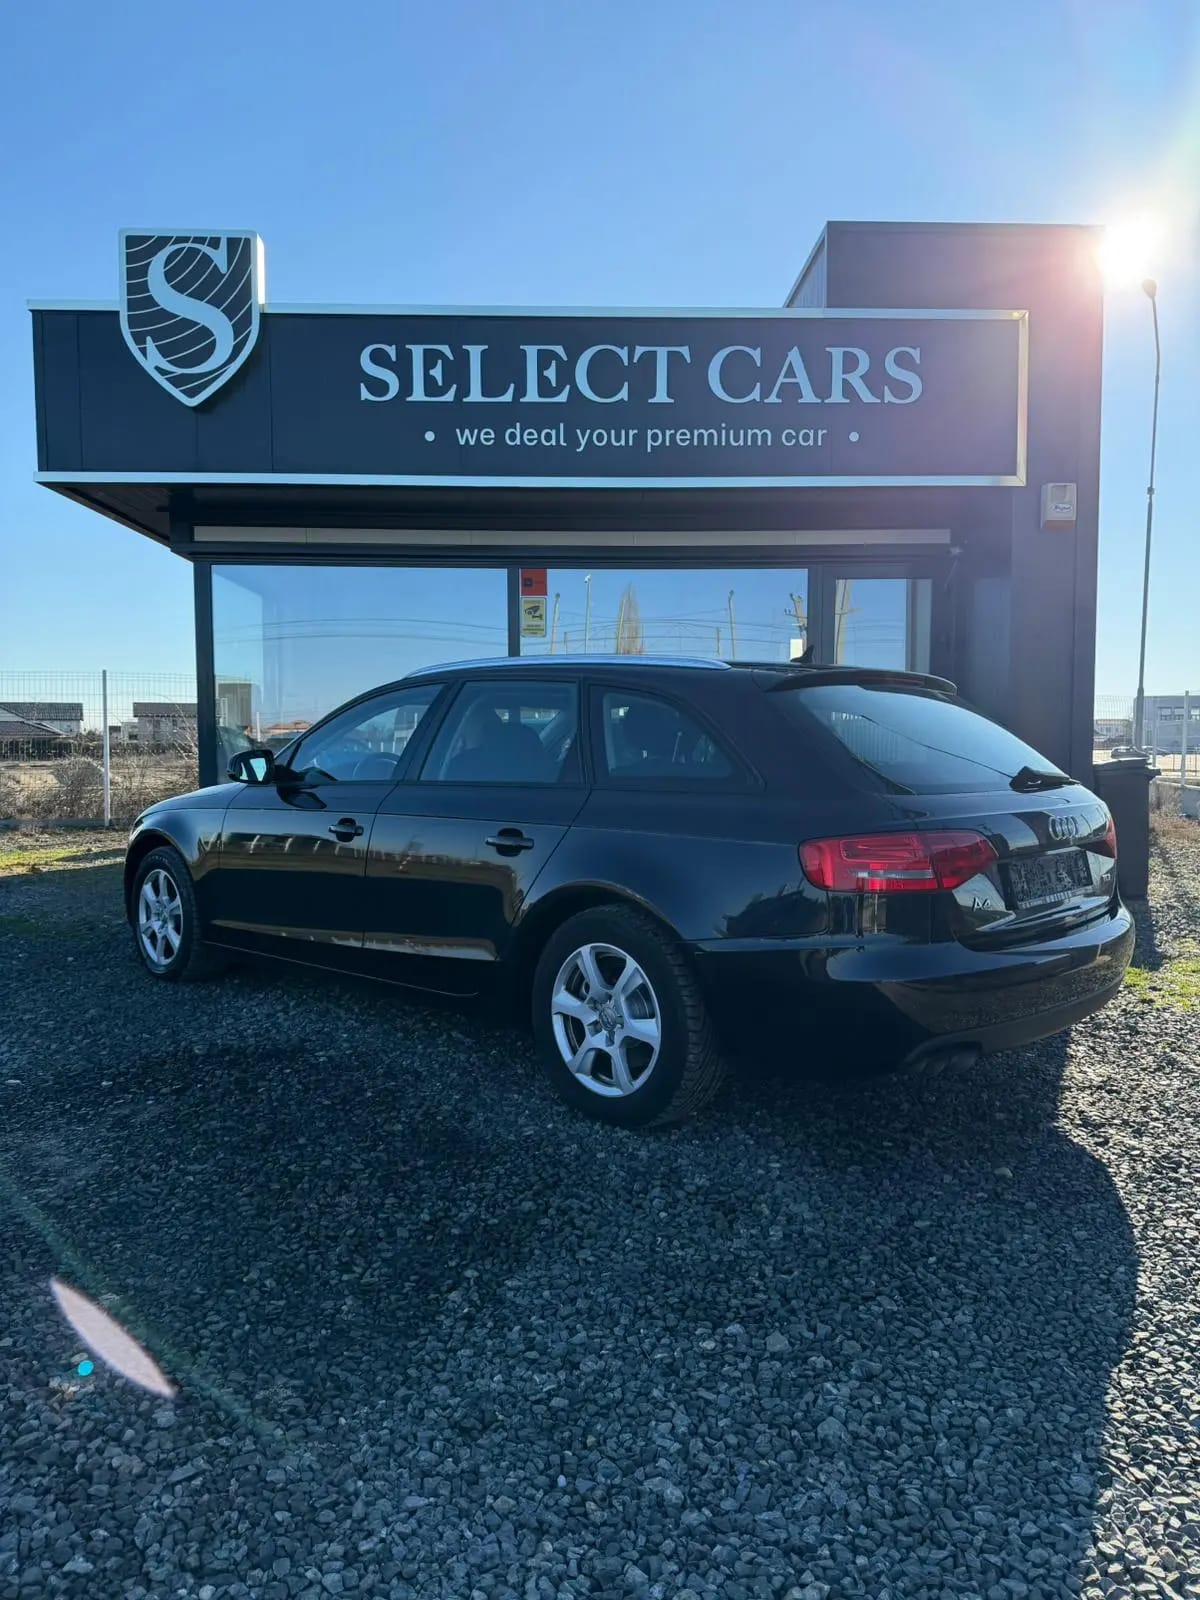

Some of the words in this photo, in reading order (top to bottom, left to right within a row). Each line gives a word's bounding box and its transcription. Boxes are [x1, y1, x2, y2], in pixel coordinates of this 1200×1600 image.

[146, 236, 235, 374] S
[358, 343, 692, 404] SELECT
[706, 344, 924, 404] CARS
[455, 427, 497, 447] we
[504, 422, 568, 447] deal
[575, 427, 639, 454] your
[646, 422, 773, 454] premium
[781, 428, 828, 447] car
